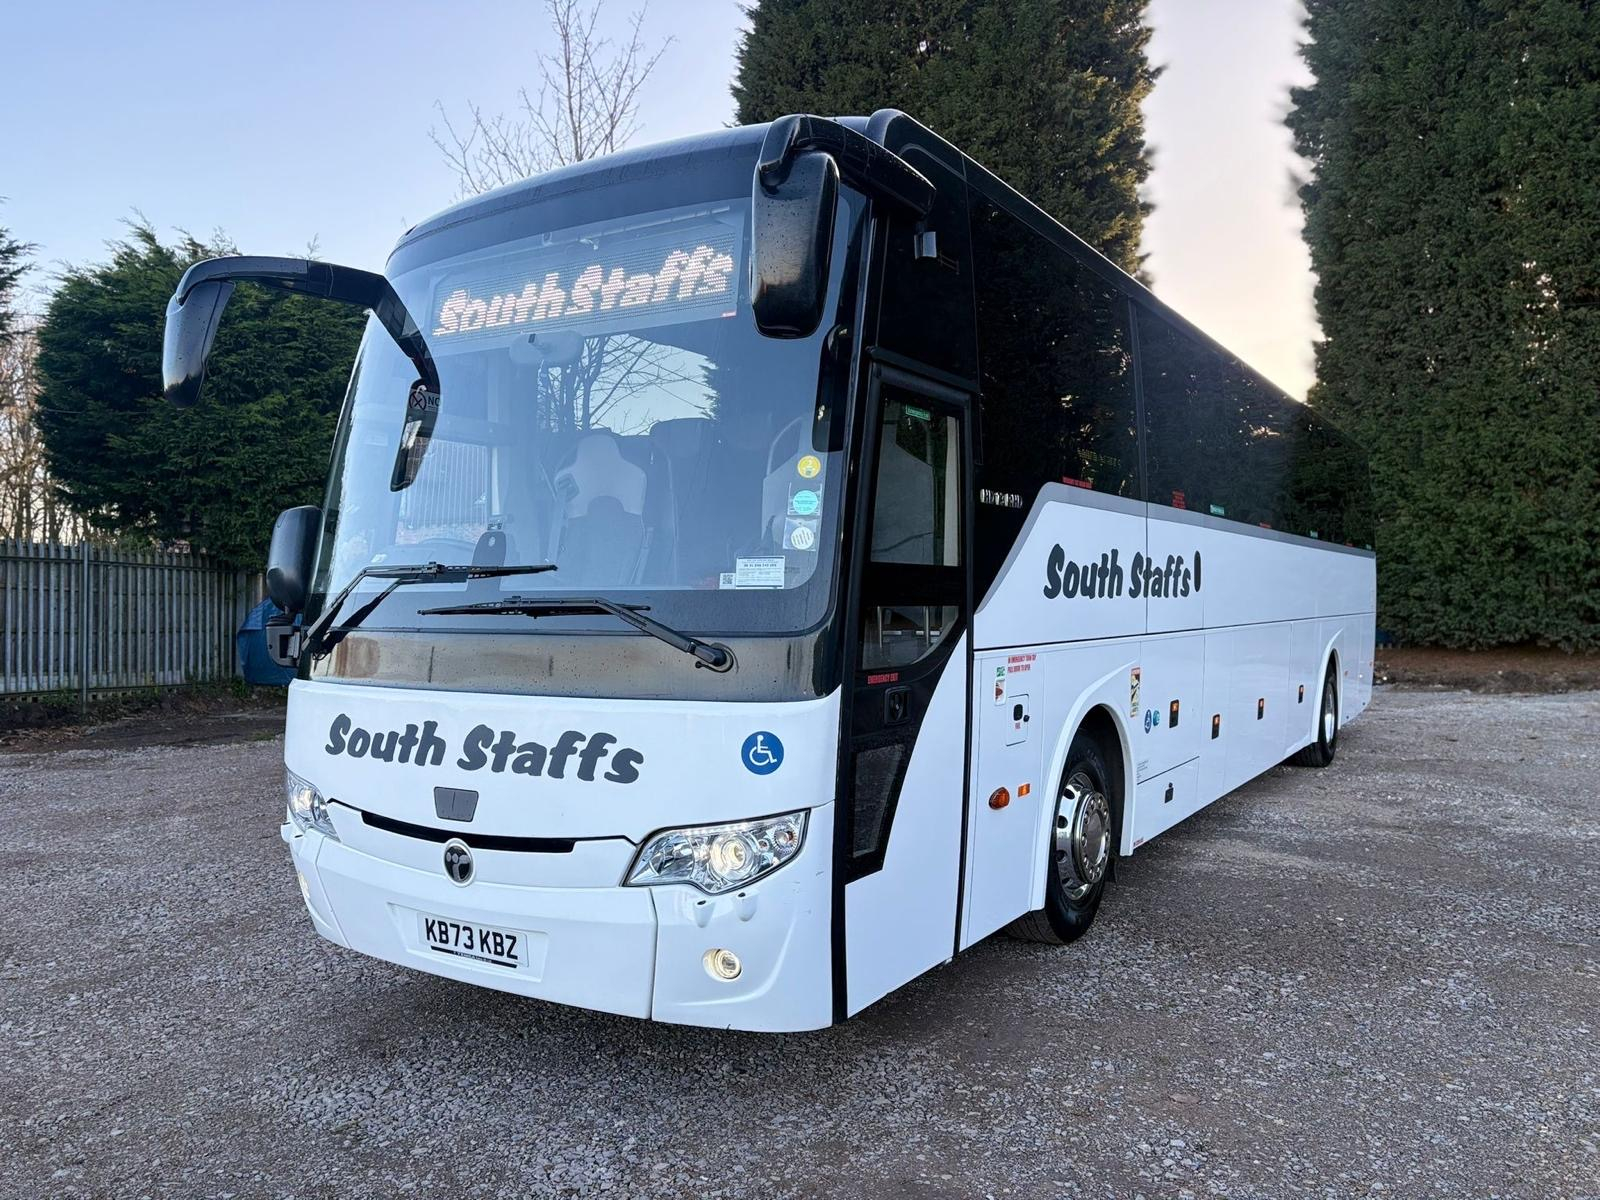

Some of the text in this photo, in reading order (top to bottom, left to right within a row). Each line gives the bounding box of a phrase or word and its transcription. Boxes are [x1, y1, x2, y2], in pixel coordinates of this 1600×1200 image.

[432, 245, 733, 336] South Staffs
[1043, 543, 1191, 600] South Staffs
[325, 713, 644, 784] South Staffs
[425, 918, 474, 950] KB73
[479, 928, 518, 960] KBZ
